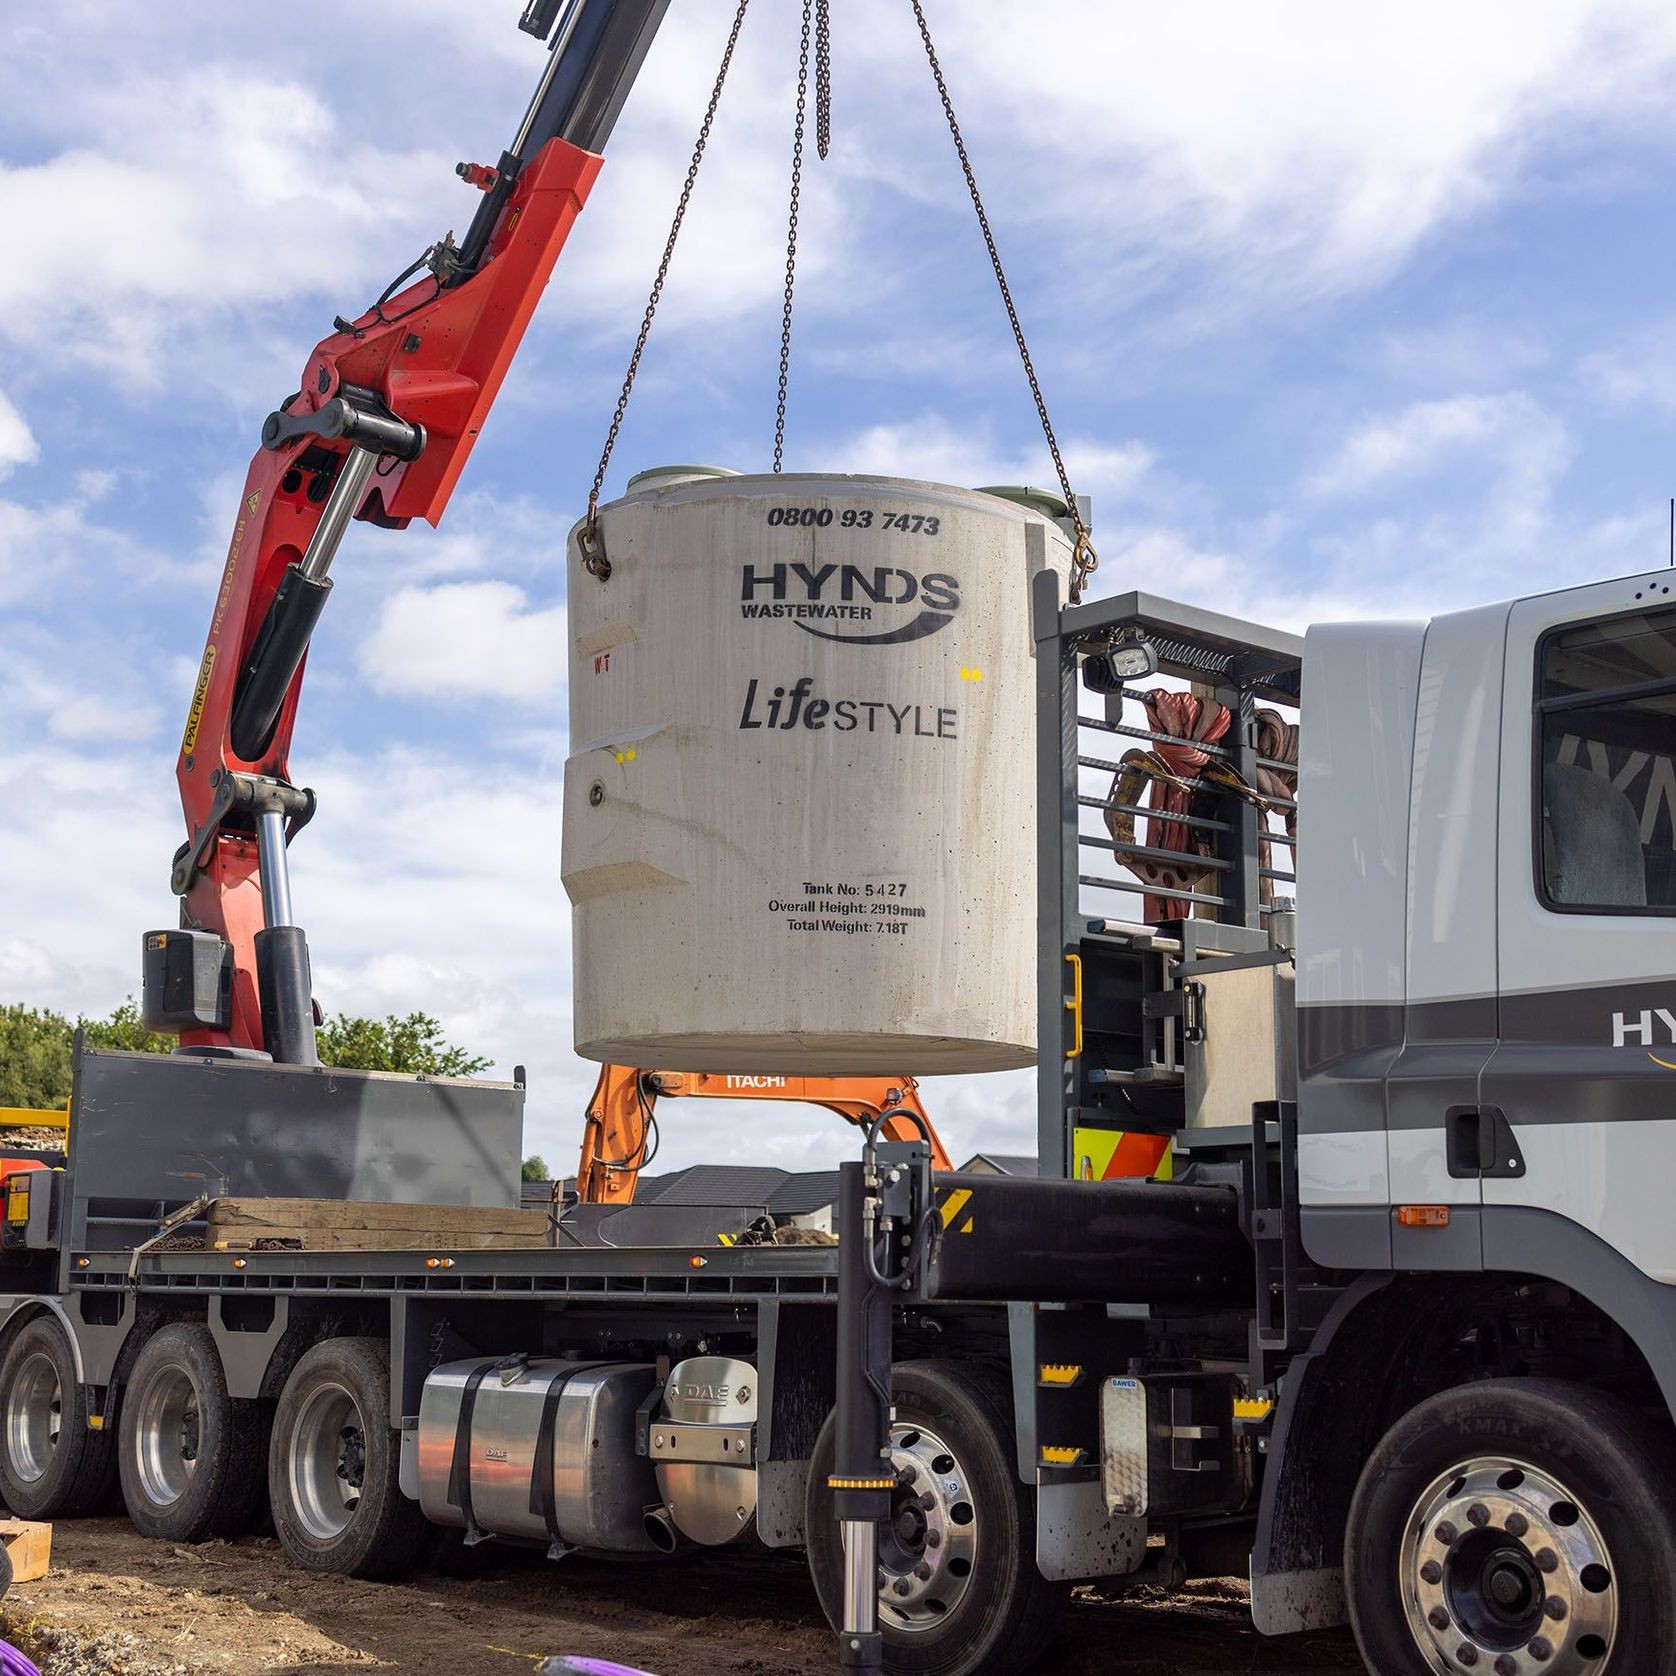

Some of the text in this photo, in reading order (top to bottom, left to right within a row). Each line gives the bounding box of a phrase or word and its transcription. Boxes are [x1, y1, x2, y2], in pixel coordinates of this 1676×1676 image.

[767, 507, 940, 536] 0800 93 7473
[741, 563, 961, 611] HYNDS
[741, 604, 872, 620] WASTEWATER
[185, 651, 215, 748] PALFINGER
[739, 677, 957, 740] LifeSTYLE
[802, 882, 833, 895] Tank
[837, 883, 860, 896] No:
[768, 900, 926, 918] Overall Height: 2919mm
[787, 919, 908, 935] Total Weight: 7.18T
[1112, 1379, 1137, 1388] BAWER
[685, 1384, 729, 1400] DAF
[486, 1448, 508, 1457] DAF
